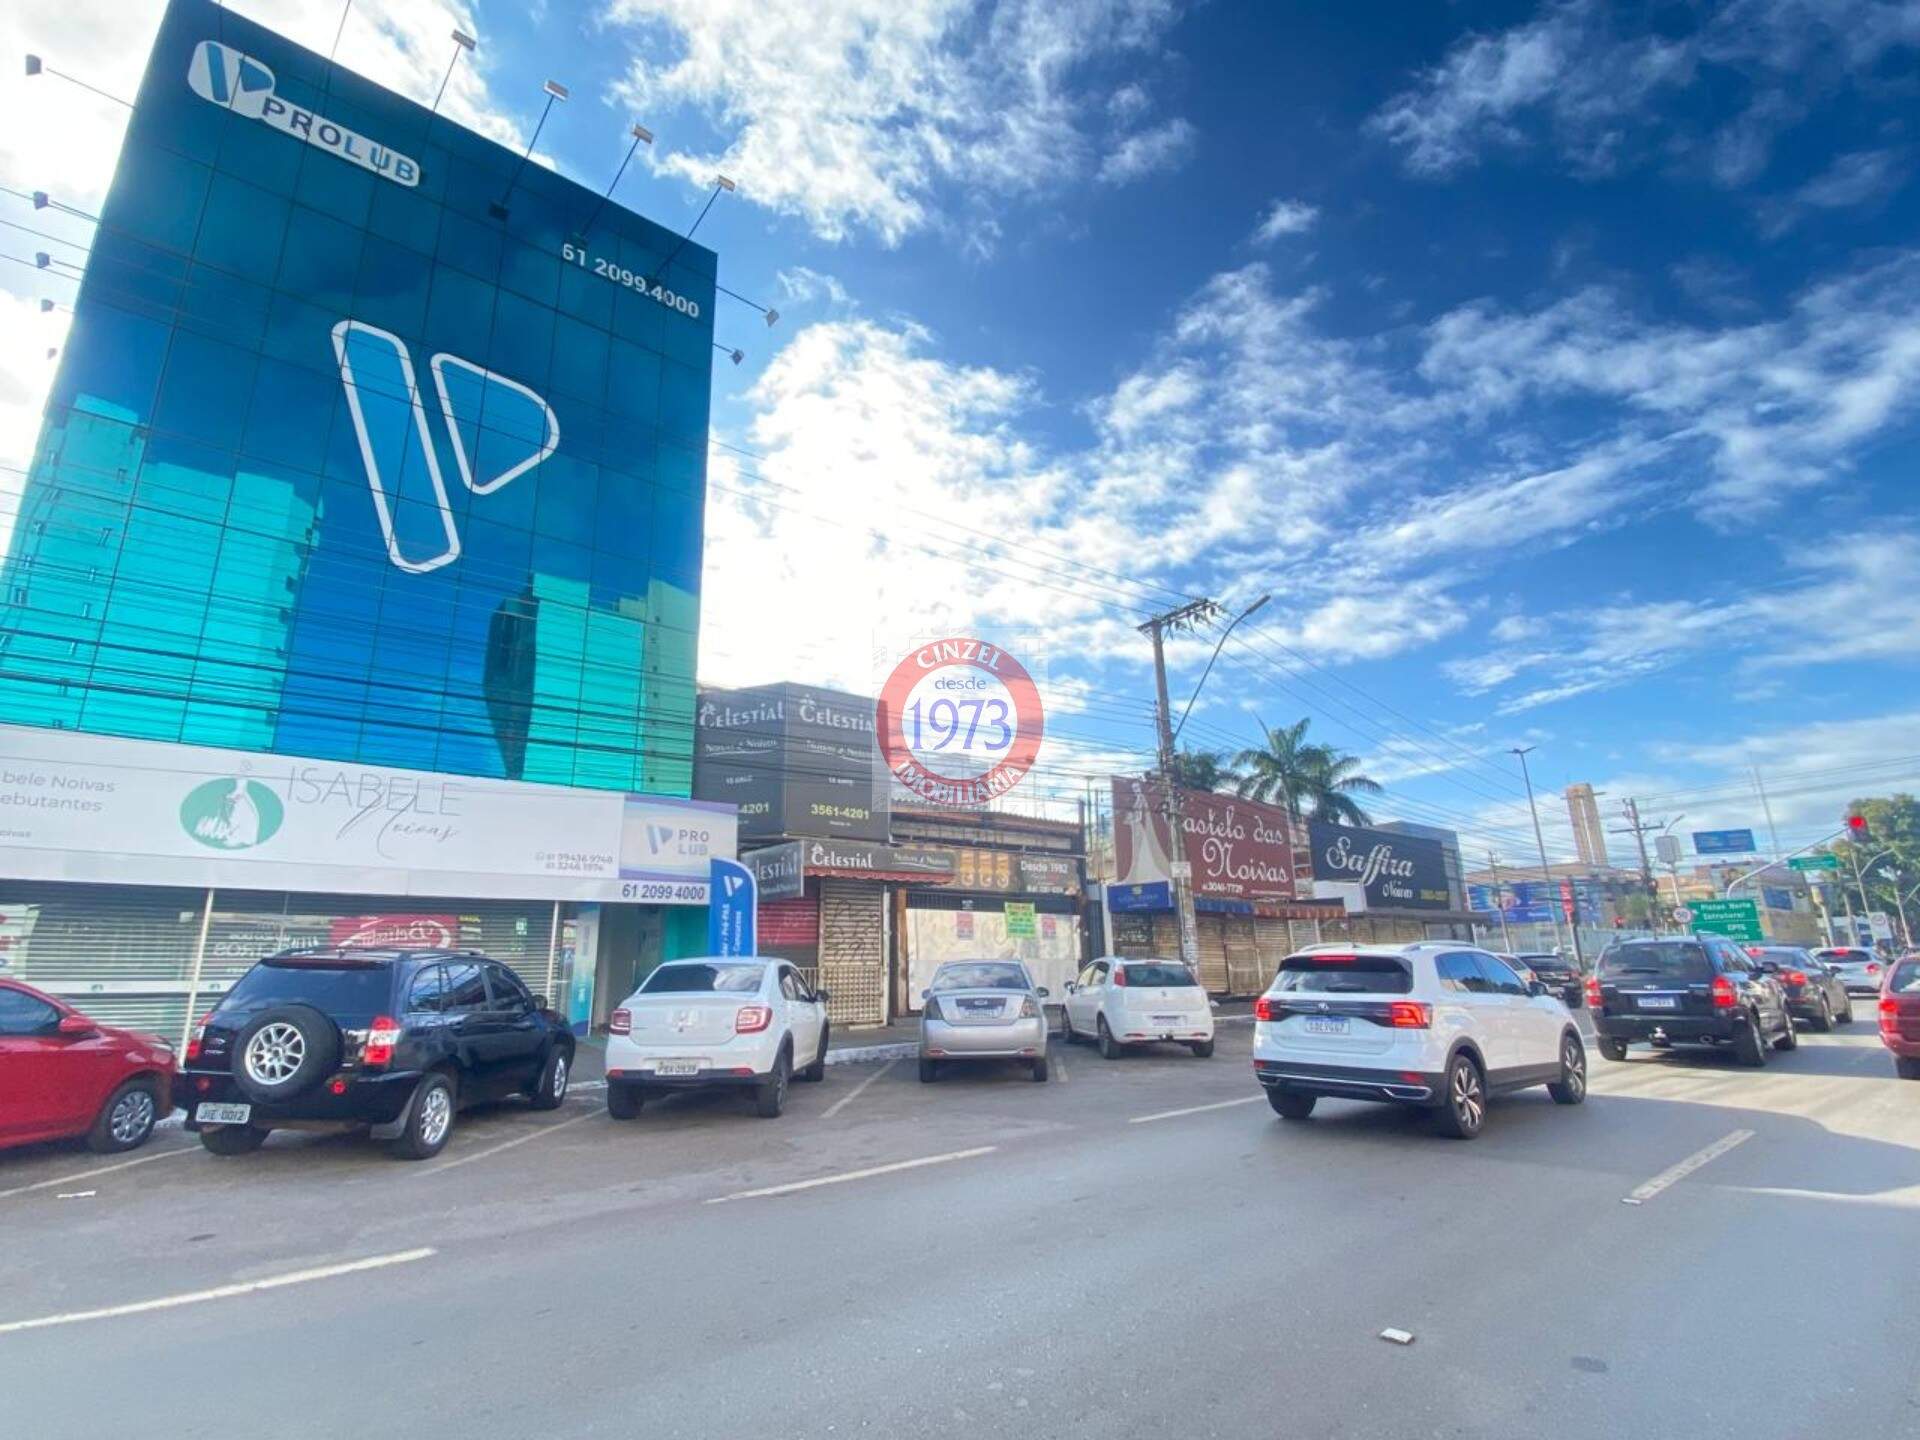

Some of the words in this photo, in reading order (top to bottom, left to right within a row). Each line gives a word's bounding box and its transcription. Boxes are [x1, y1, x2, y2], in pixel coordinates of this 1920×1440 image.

[262, 96, 415, 181] PROLUB
[562, 243, 586, 267] 61
[595, 258, 700, 318] 2099.4000
[800, 703, 874, 732] CELESTIA
[2, 771, 47, 787] bele
[51, 775, 116, 792] Noivas
[288, 767, 463, 817] ISABELE
[0, 792, 103, 811] ebutantes
[739, 803, 769, 814] -4201
[811, 804, 869, 819] 3561-4201
[1164, 799, 1245, 839] astelo
[1253, 815, 1283, 844] das
[678, 829, 710, 842] PRO
[678, 844, 708, 855] LUB
[1202, 837, 1289, 882] Noivas
[1326, 836, 1415, 886] Saffira
[622, 884, 638, 898] 61
[641, 885, 672, 899] 2099
[675, 886, 705, 900] 4000
